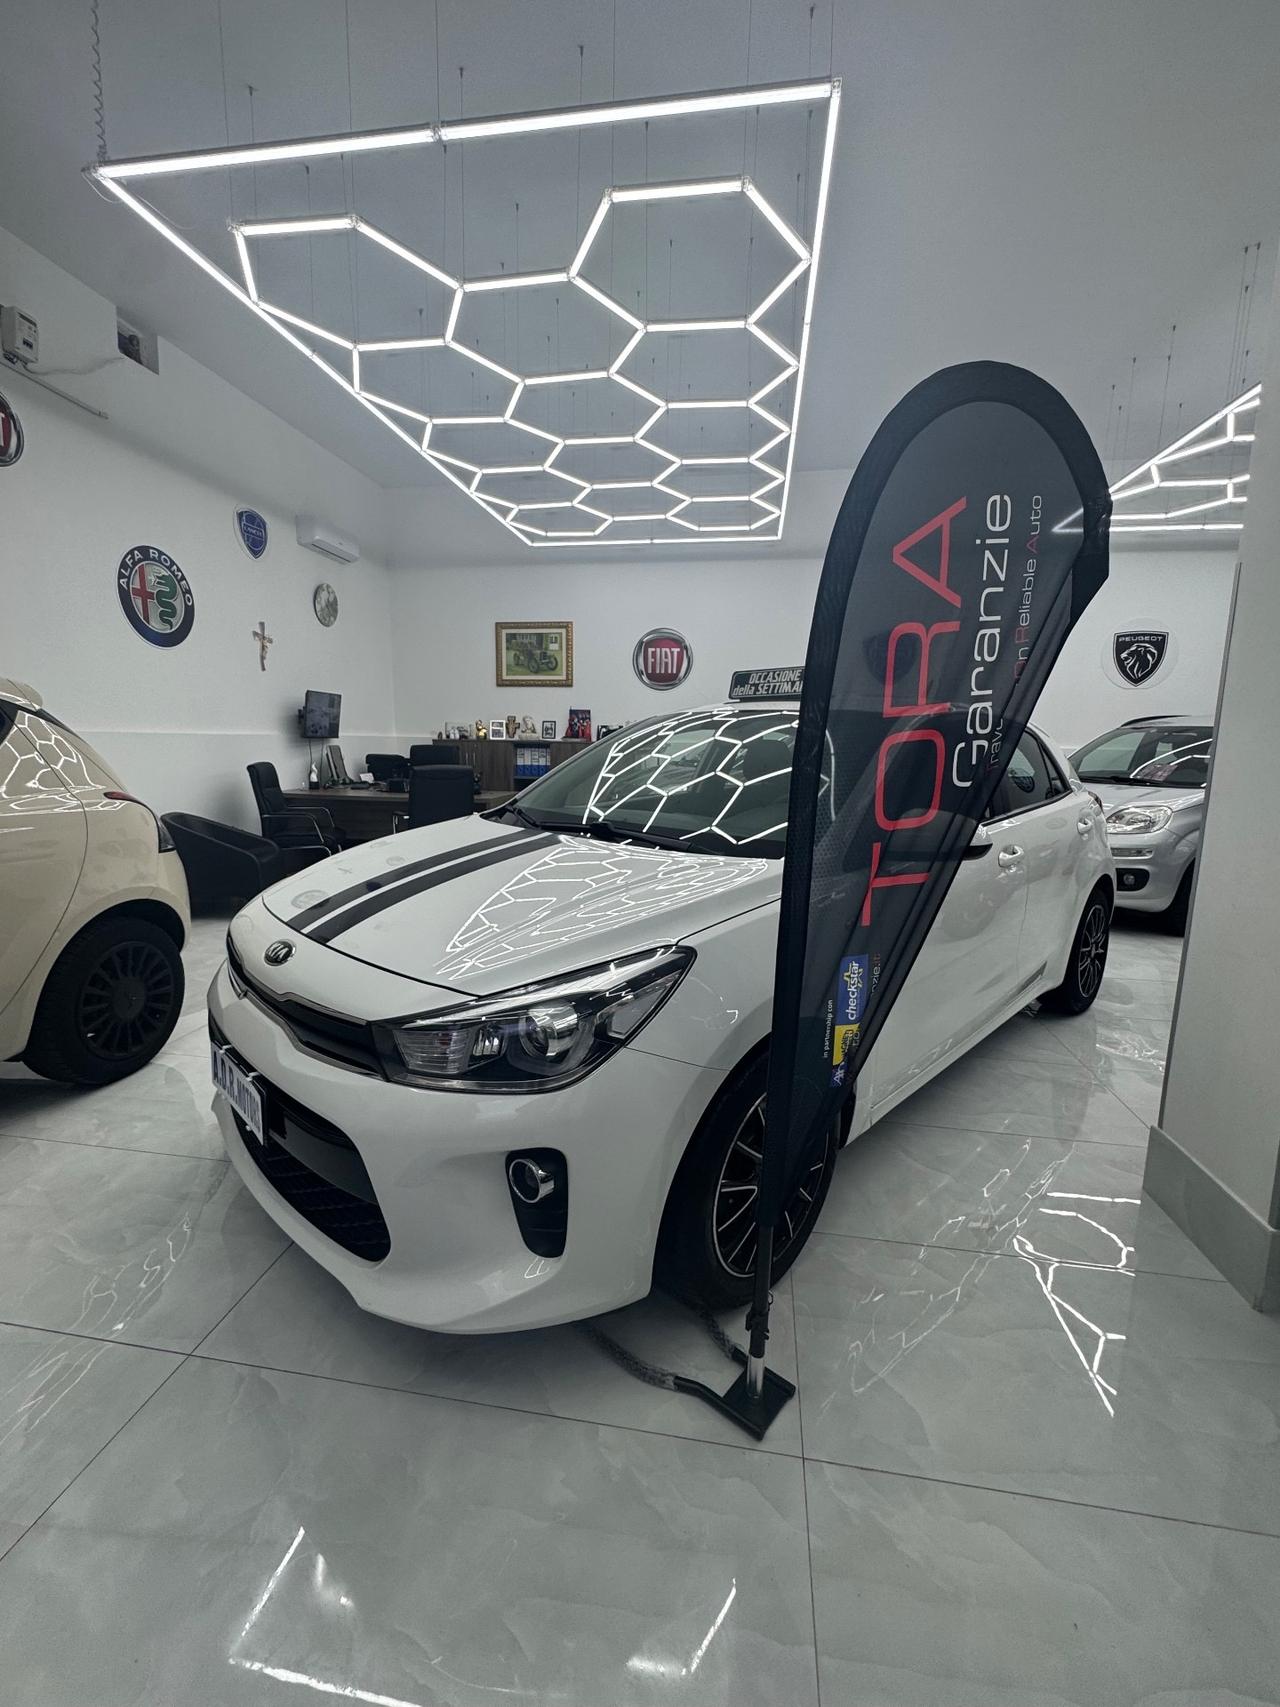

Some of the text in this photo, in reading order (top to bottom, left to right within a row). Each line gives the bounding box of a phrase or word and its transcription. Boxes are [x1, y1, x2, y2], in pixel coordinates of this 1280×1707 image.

[120, 549, 193, 606] ALFA ROMEO
[1015, 559, 1036, 643] Reliable
[1026, 495, 1042, 553] Auto
[647, 648, 680, 674] FIAT
[953, 494, 1011, 788] Garanzie
[732, 680, 804, 696] della SETTIMA
[749, 669, 802, 684] OCCASIONE
[861, 496, 967, 926] TORA
[845, 961, 859, 1020] checkstar
[824, 1013, 833, 1050] partnership
